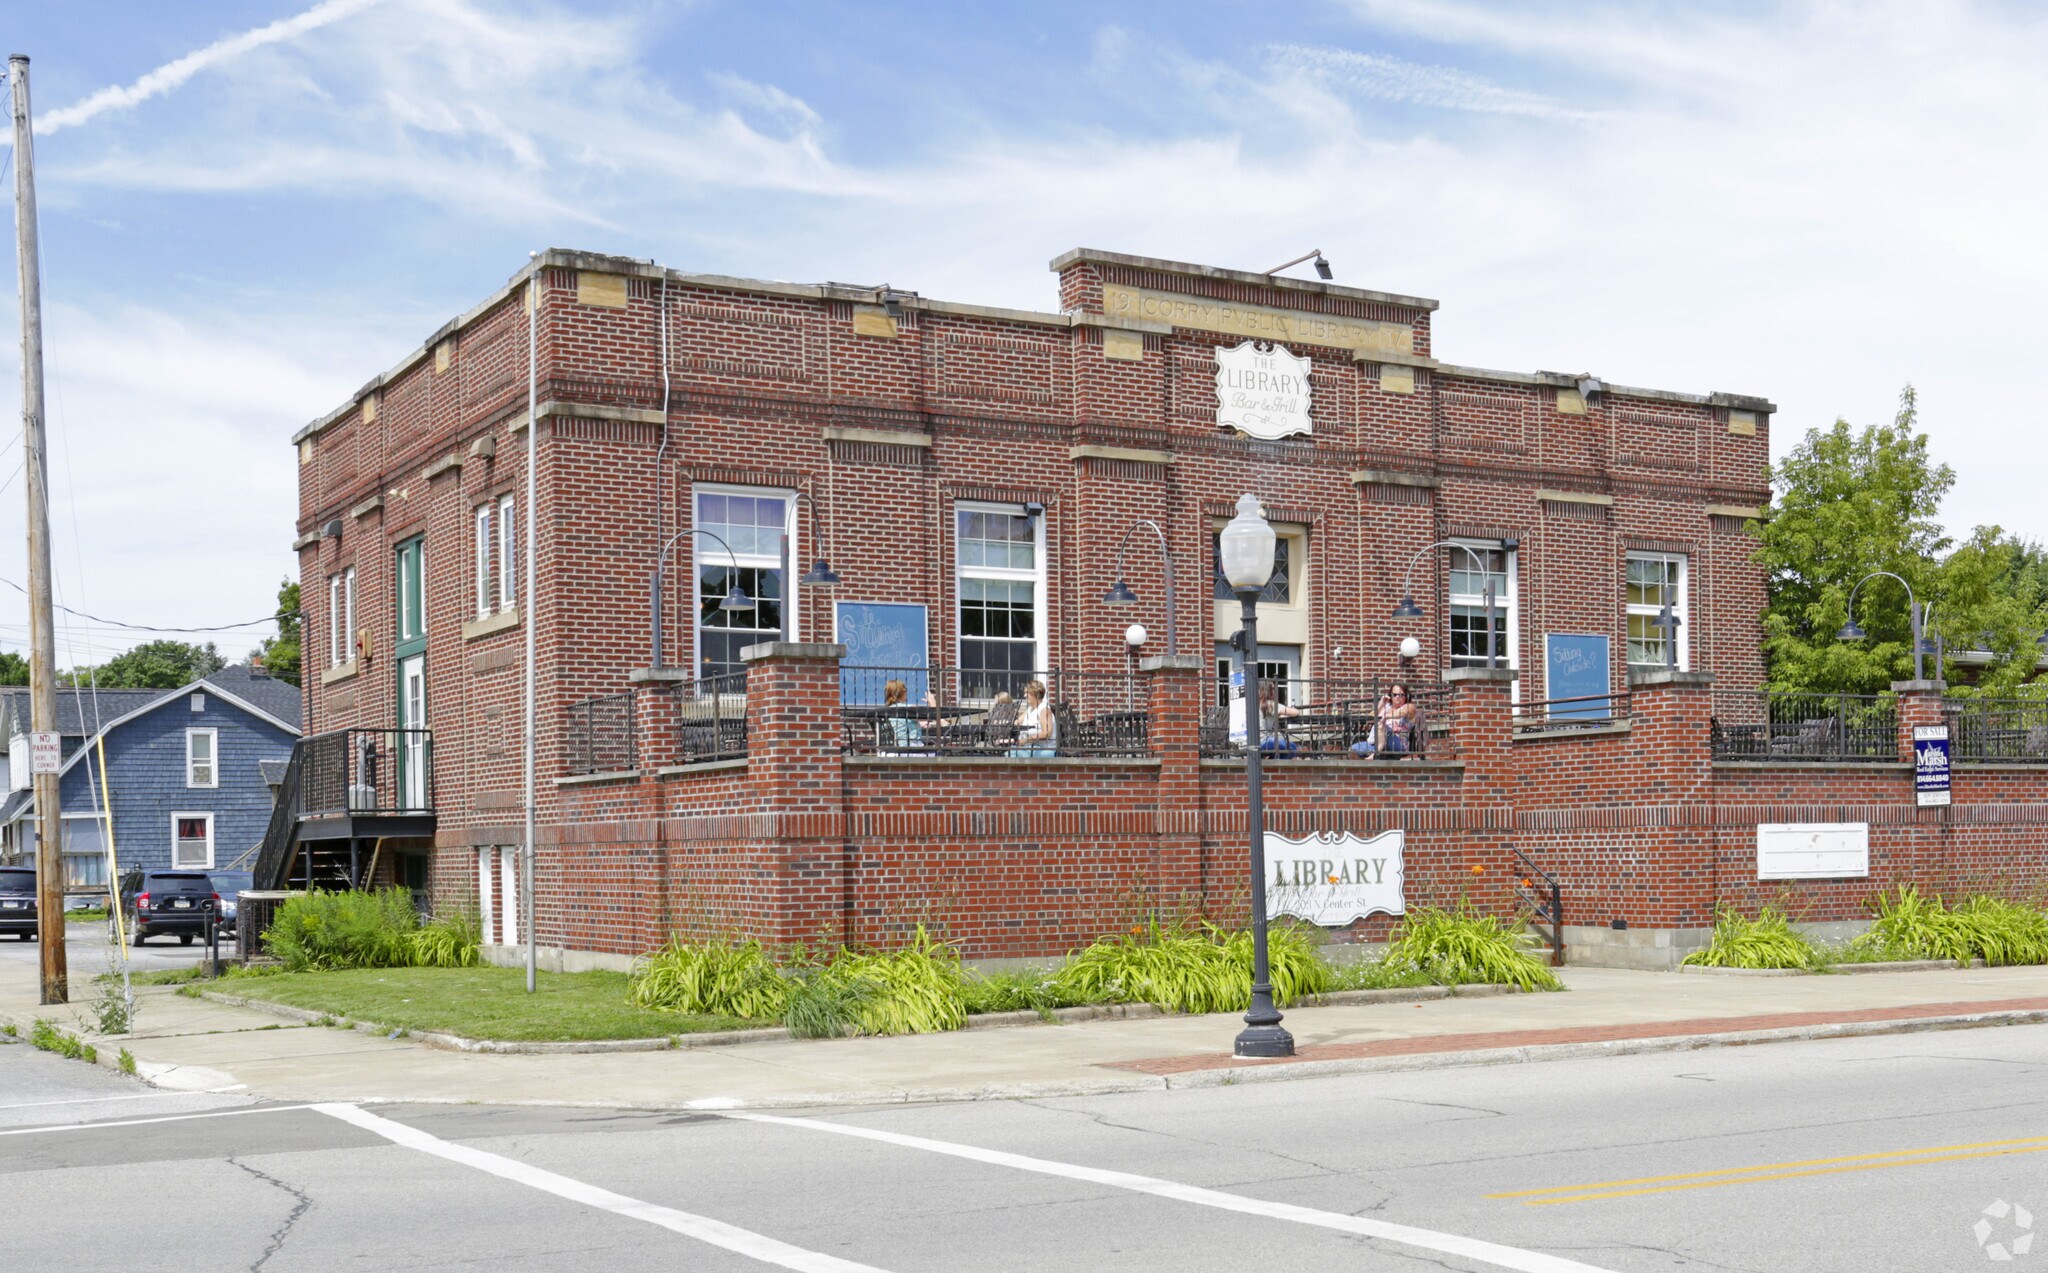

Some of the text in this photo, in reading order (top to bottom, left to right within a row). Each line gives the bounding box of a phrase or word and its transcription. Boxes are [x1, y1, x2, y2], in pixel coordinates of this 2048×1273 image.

[1112, 291, 1130, 310] 19
[1144, 296, 1214, 322] CORRY
[1298, 318, 1376, 344] LIBRARY
[1253, 356, 1277, 370] THE
[1228, 368, 1303, 395] LIBRARY
[1231, 392, 1299, 414] Bar & Grill
[1915, 727, 1946, 737] FOR SALE
[1916, 749, 1948, 766] Marsh
[1274, 857, 1387, 887] LIBRARY
[1356, 897, 1367, 908] St
